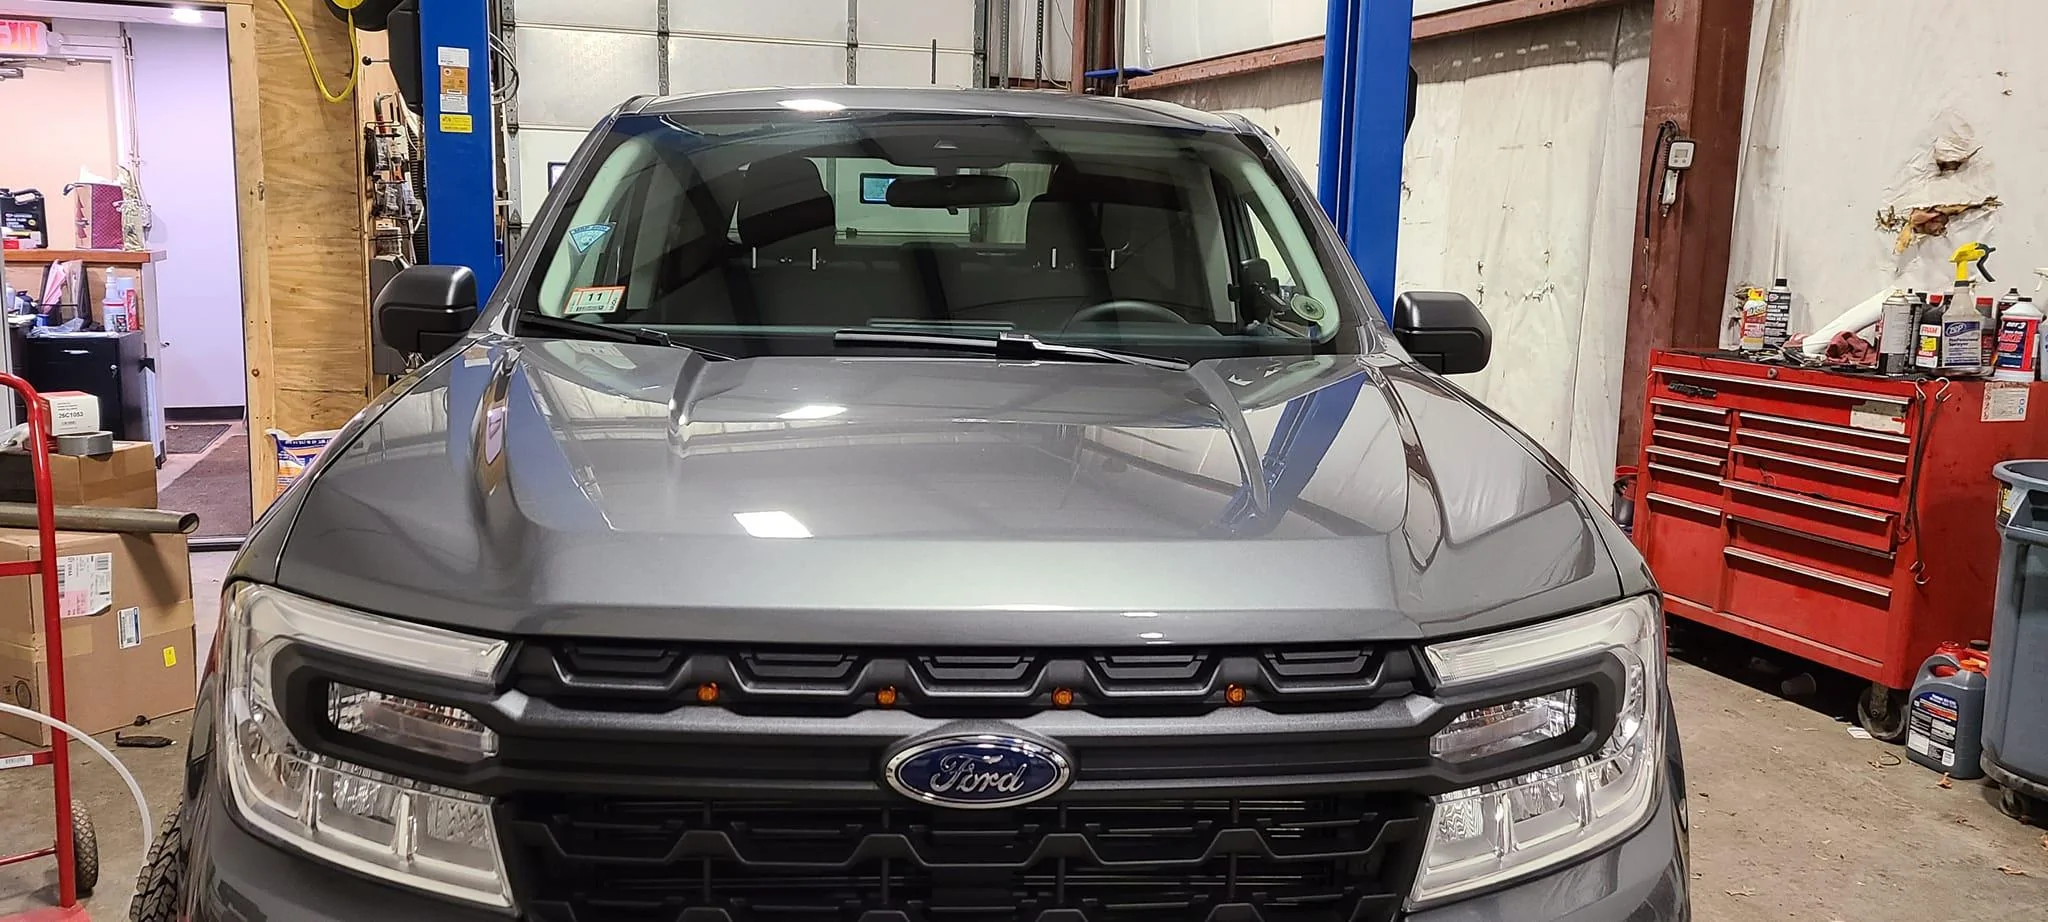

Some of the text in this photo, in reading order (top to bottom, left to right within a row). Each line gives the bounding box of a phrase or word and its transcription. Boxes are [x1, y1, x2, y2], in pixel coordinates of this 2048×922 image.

[0, 21, 38, 51] EXIT
[588, 293, 603, 302] 11
[930, 753, 1028, 792] Ford
